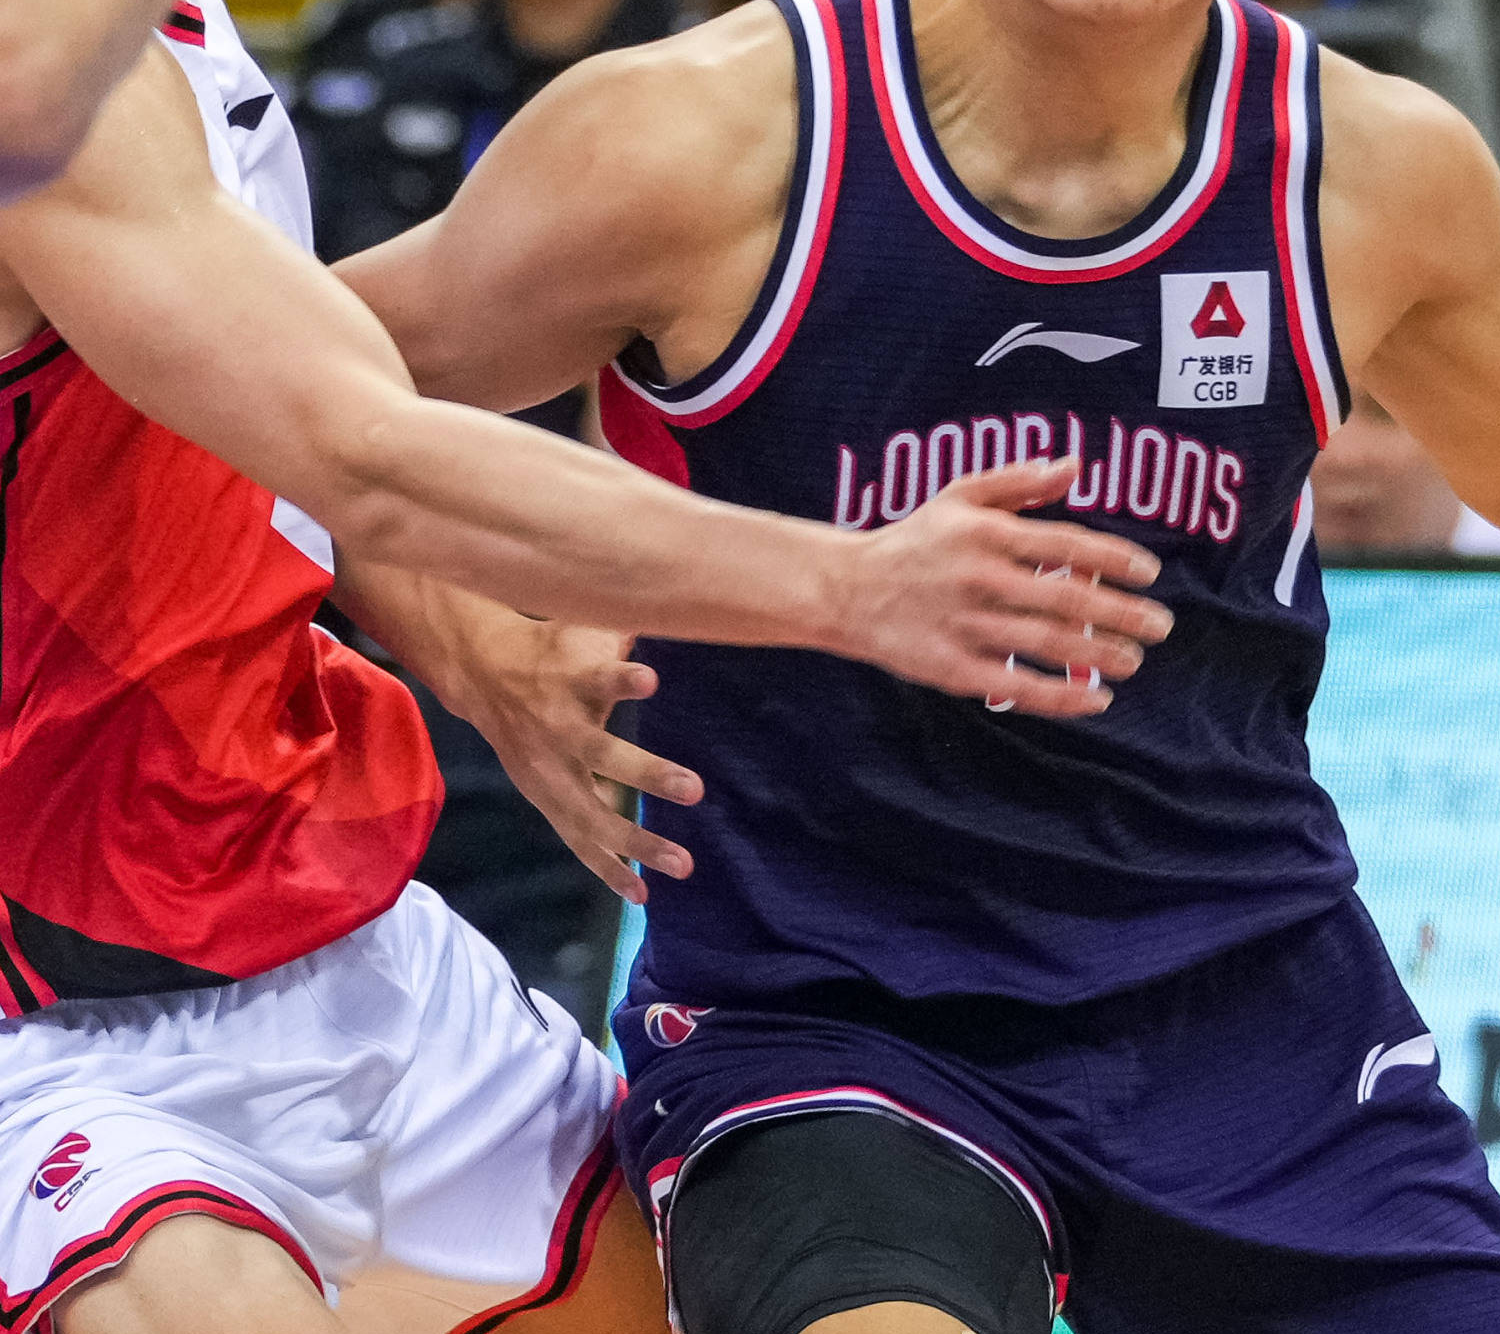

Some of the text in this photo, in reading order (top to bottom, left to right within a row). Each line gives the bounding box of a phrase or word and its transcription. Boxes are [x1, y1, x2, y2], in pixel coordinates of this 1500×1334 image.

[1178, 354, 1254, 376] 广发银行
[1193, 380, 1238, 402] CGB
